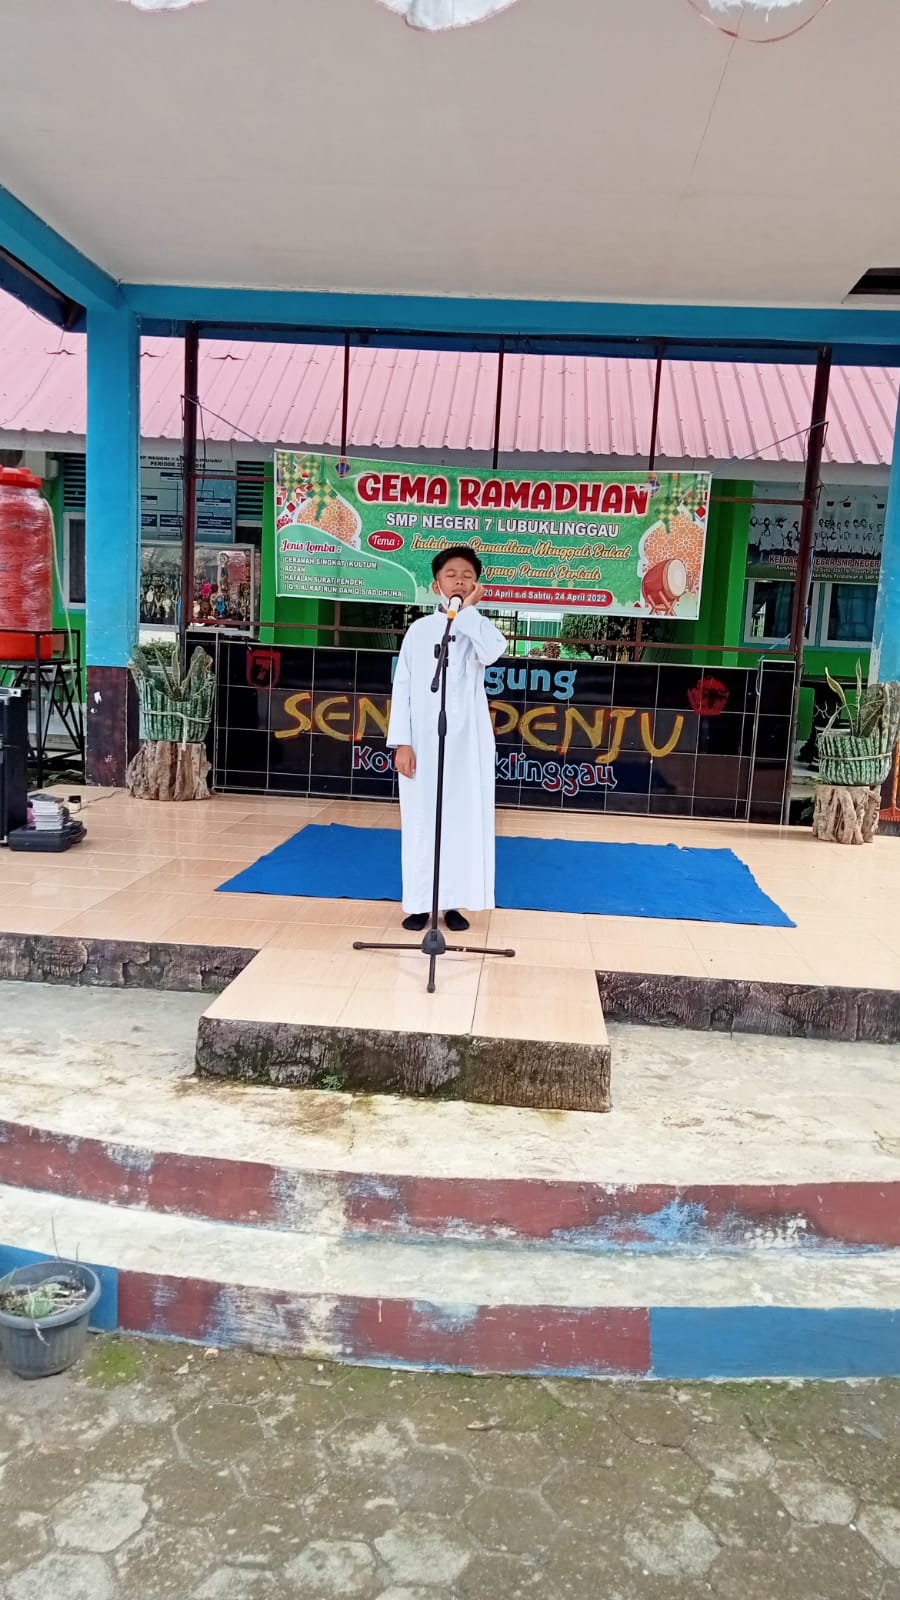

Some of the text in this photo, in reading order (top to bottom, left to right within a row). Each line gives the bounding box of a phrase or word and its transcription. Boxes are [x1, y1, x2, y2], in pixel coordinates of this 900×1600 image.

[357, 473, 648, 514] GEMA RAMADHAN
[386, 512, 619, 537] SMP NEGERI 7 LUBUKLINGGAU
[281, 540, 303, 552] Jenis
[306, 541, 335, 553] Lomba
[371, 535, 395, 546] Tema
[470, 538, 532, 555] Ramadhan
[284, 556, 314, 564] CERAMAH
[855, 560, 881, 568] NEGER
[487, 563, 601, 580] yang Penuh Berkah
[336, 578, 363, 586] PENDEK
[495, 590, 513, 599] April
[528, 592, 552, 600] Sabtu,
[567, 594, 585, 602] April
